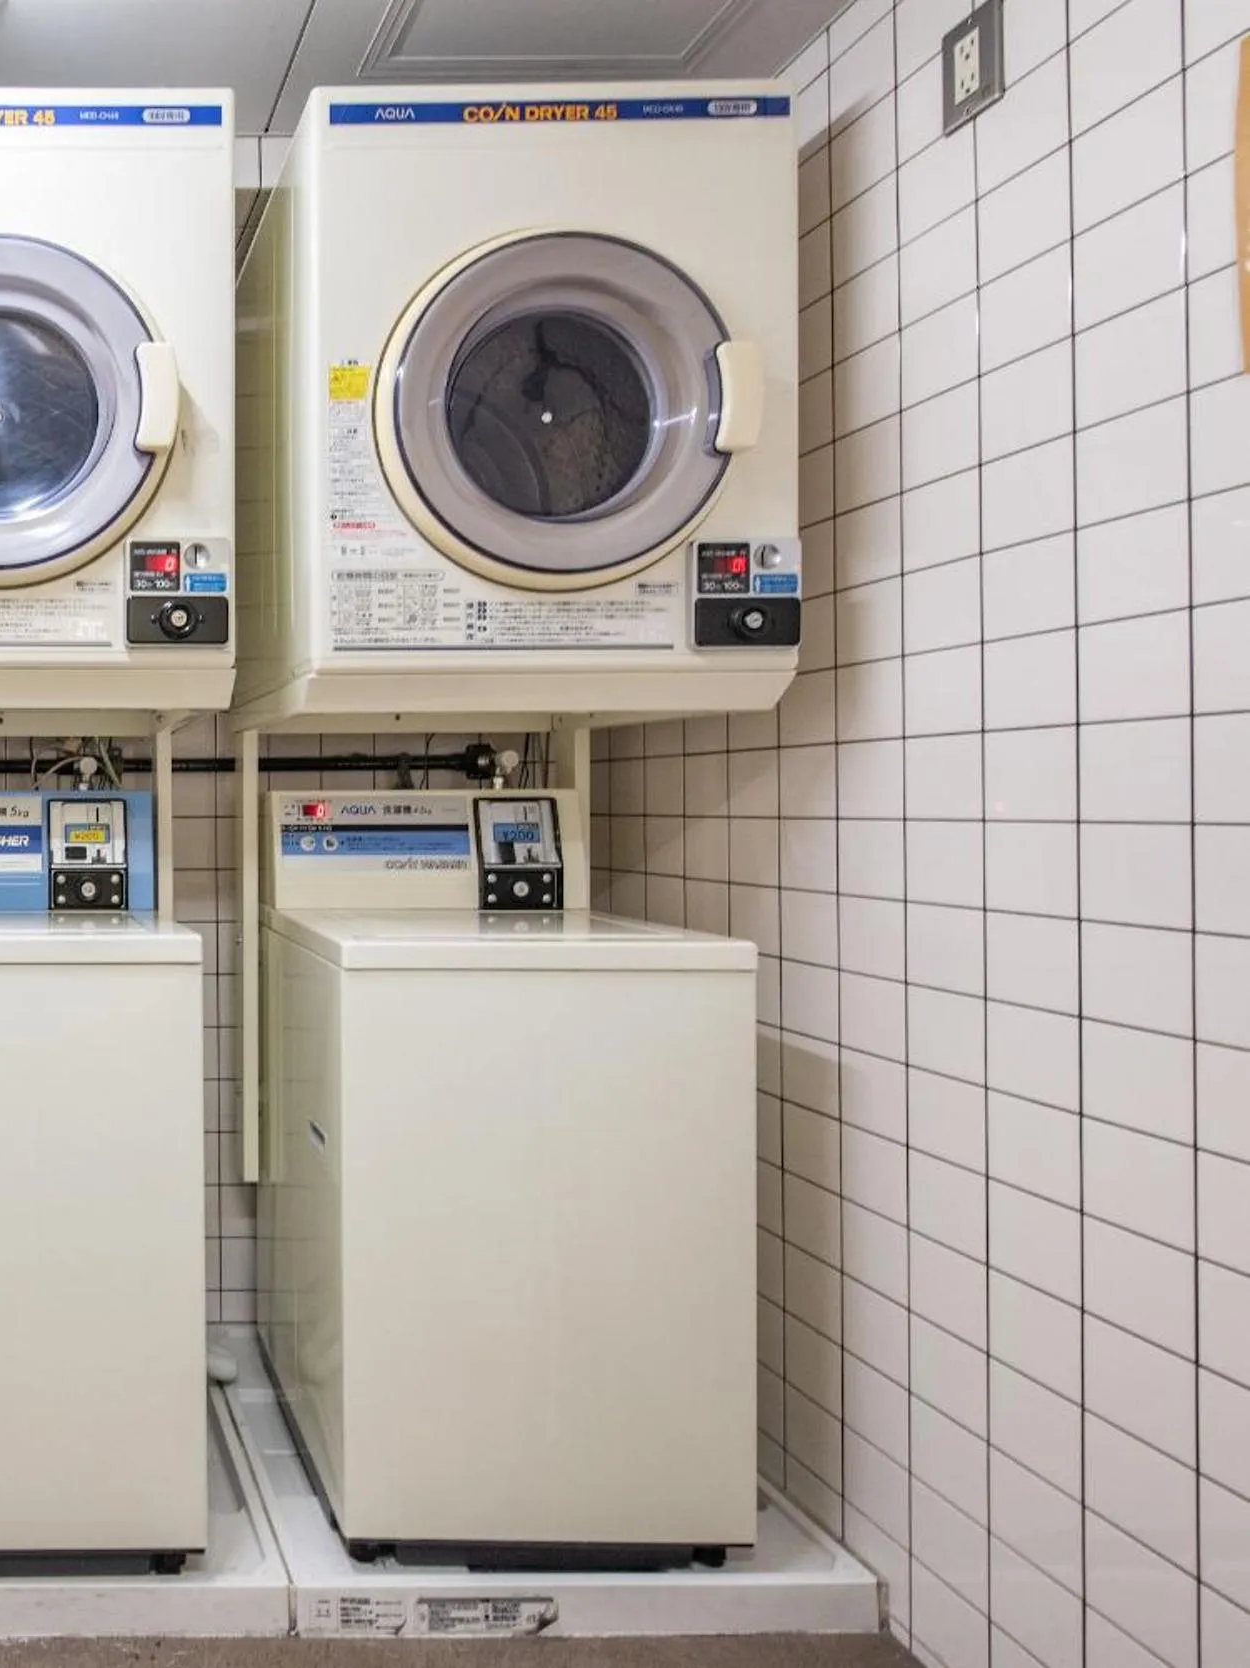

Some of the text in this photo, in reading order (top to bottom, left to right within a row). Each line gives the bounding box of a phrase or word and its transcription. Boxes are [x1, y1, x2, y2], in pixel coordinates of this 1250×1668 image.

[33, 110, 55, 125] 45
[375, 107, 415, 119] AQUA
[525, 105, 589, 121] DRYER
[594, 104, 617, 119] 45
[9, 806, 30, 818] 5kg
[341, 805, 376, 815] AQUA
